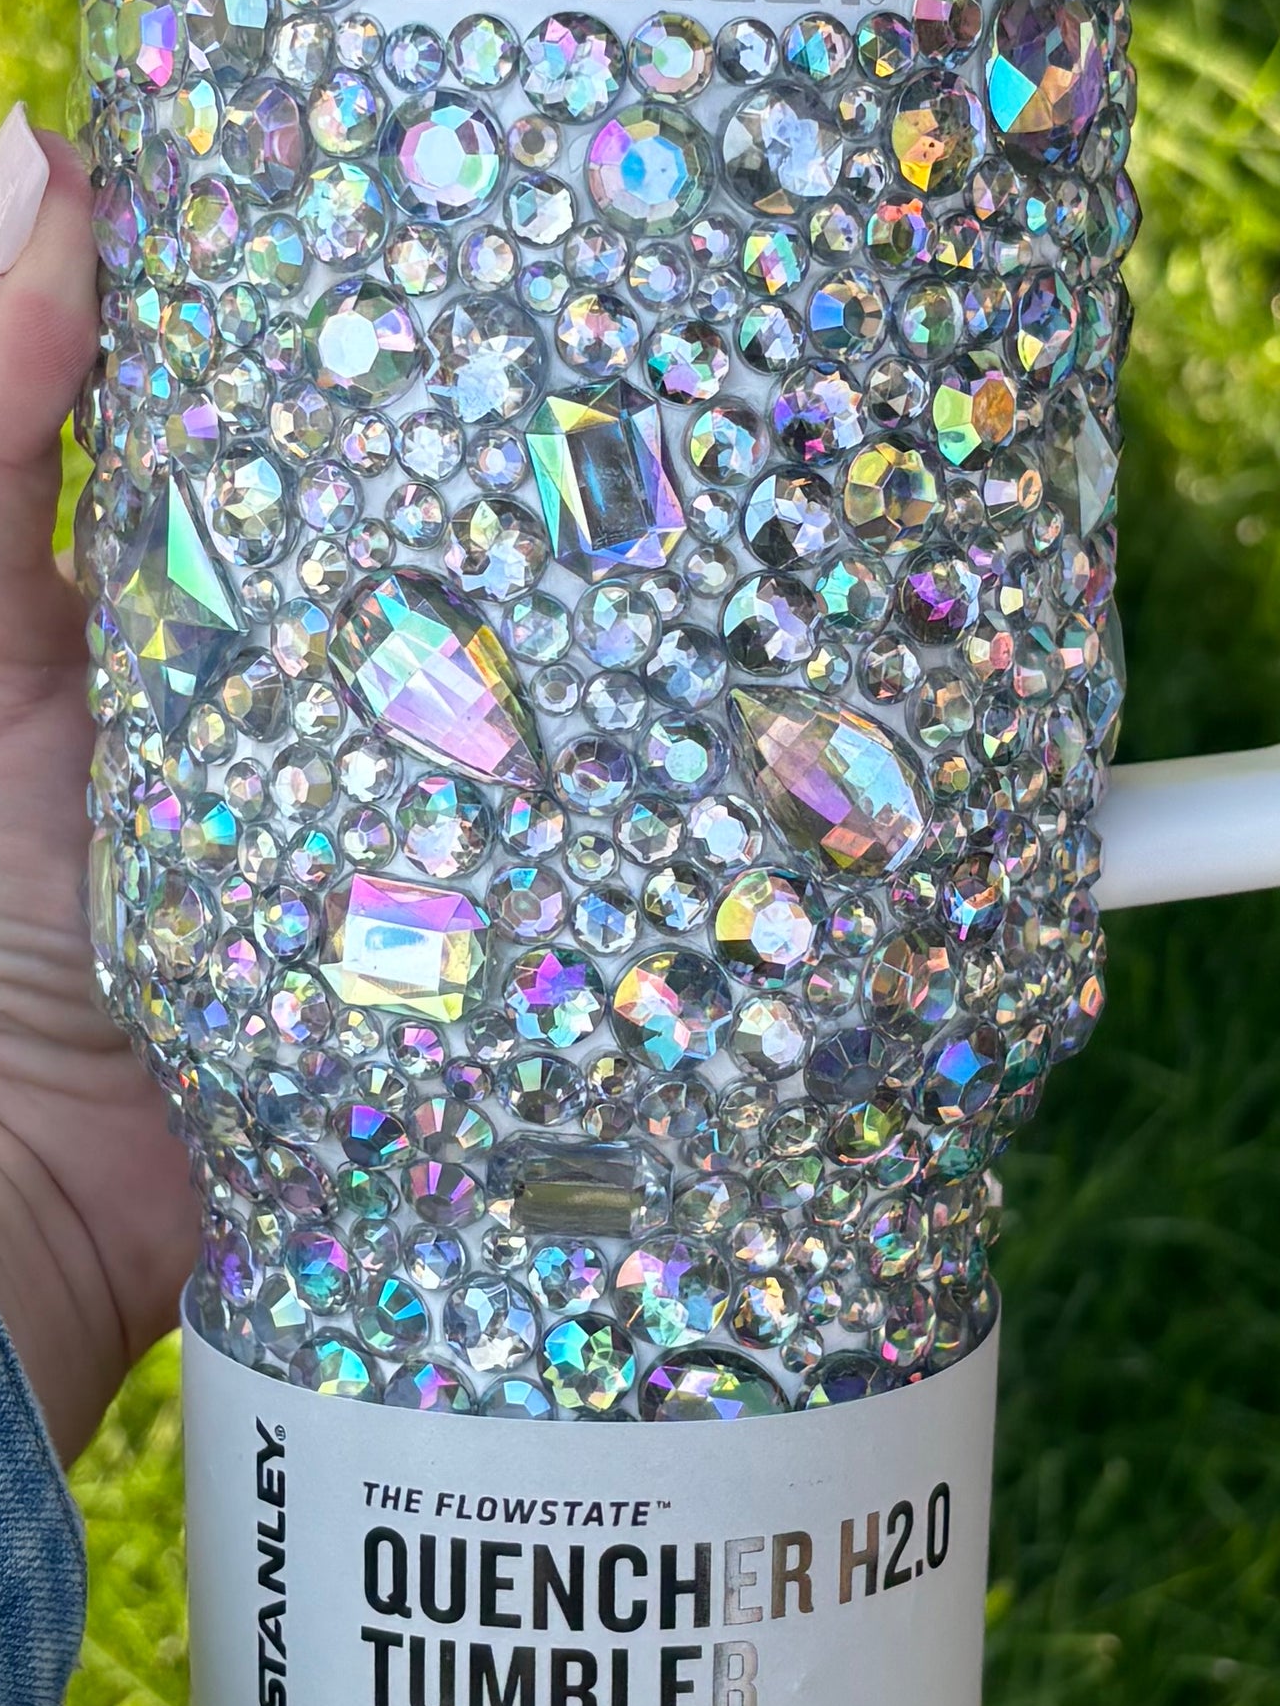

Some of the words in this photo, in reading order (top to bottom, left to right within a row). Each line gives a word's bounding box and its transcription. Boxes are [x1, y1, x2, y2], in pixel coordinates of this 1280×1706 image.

[363, 1481, 422, 1515] THE
[361, 1526, 815, 1633] QUENCHER
[838, 1481, 950, 1605] H2.0
